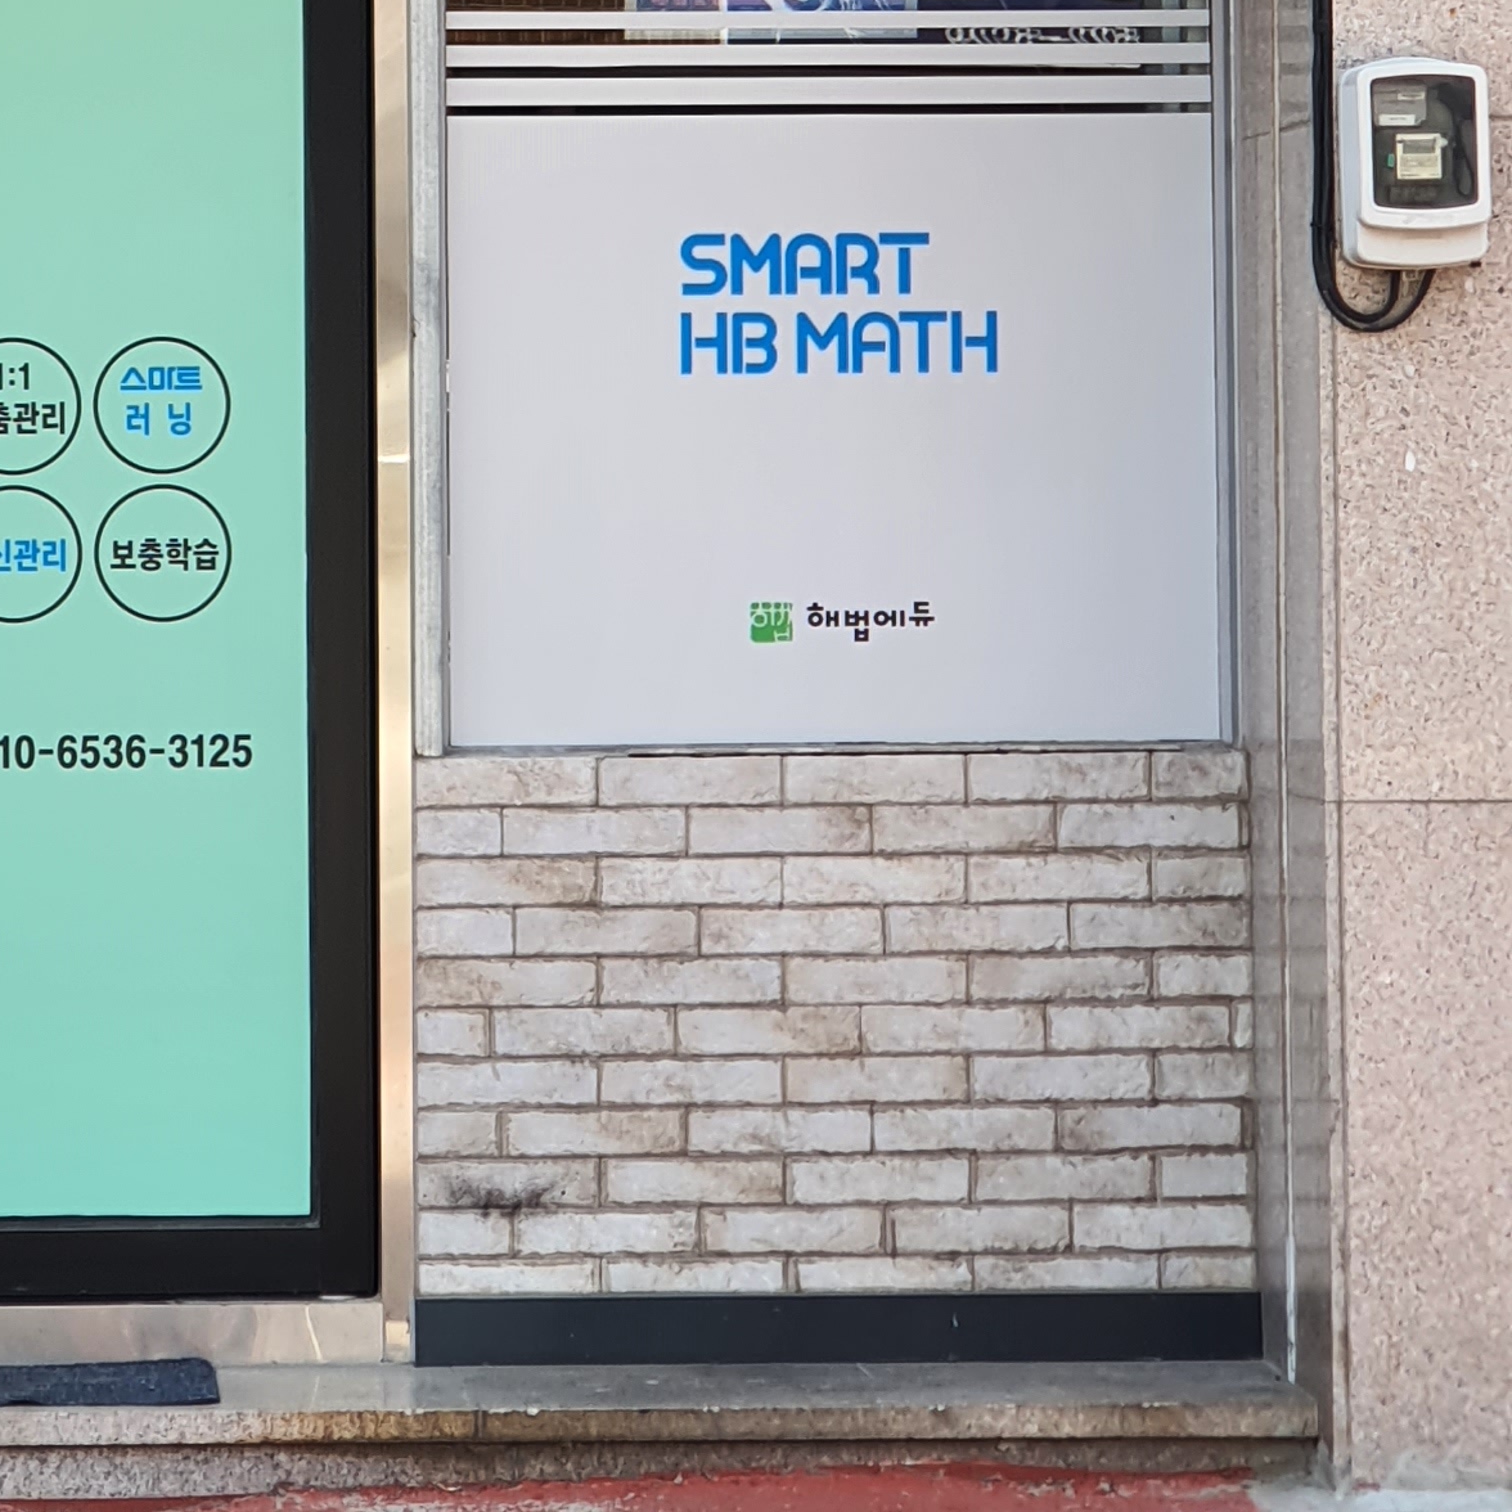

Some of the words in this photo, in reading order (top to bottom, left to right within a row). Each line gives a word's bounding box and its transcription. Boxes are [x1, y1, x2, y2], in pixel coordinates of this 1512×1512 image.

[680, 232, 930, 295] SMART
[680, 312, 778, 374] HB
[796, 310, 998, 374] MATH
[119, 366, 203, 391] 스마트
[110, 538, 220, 571] 보충학습
[806, 601, 936, 642] 해법에듀
